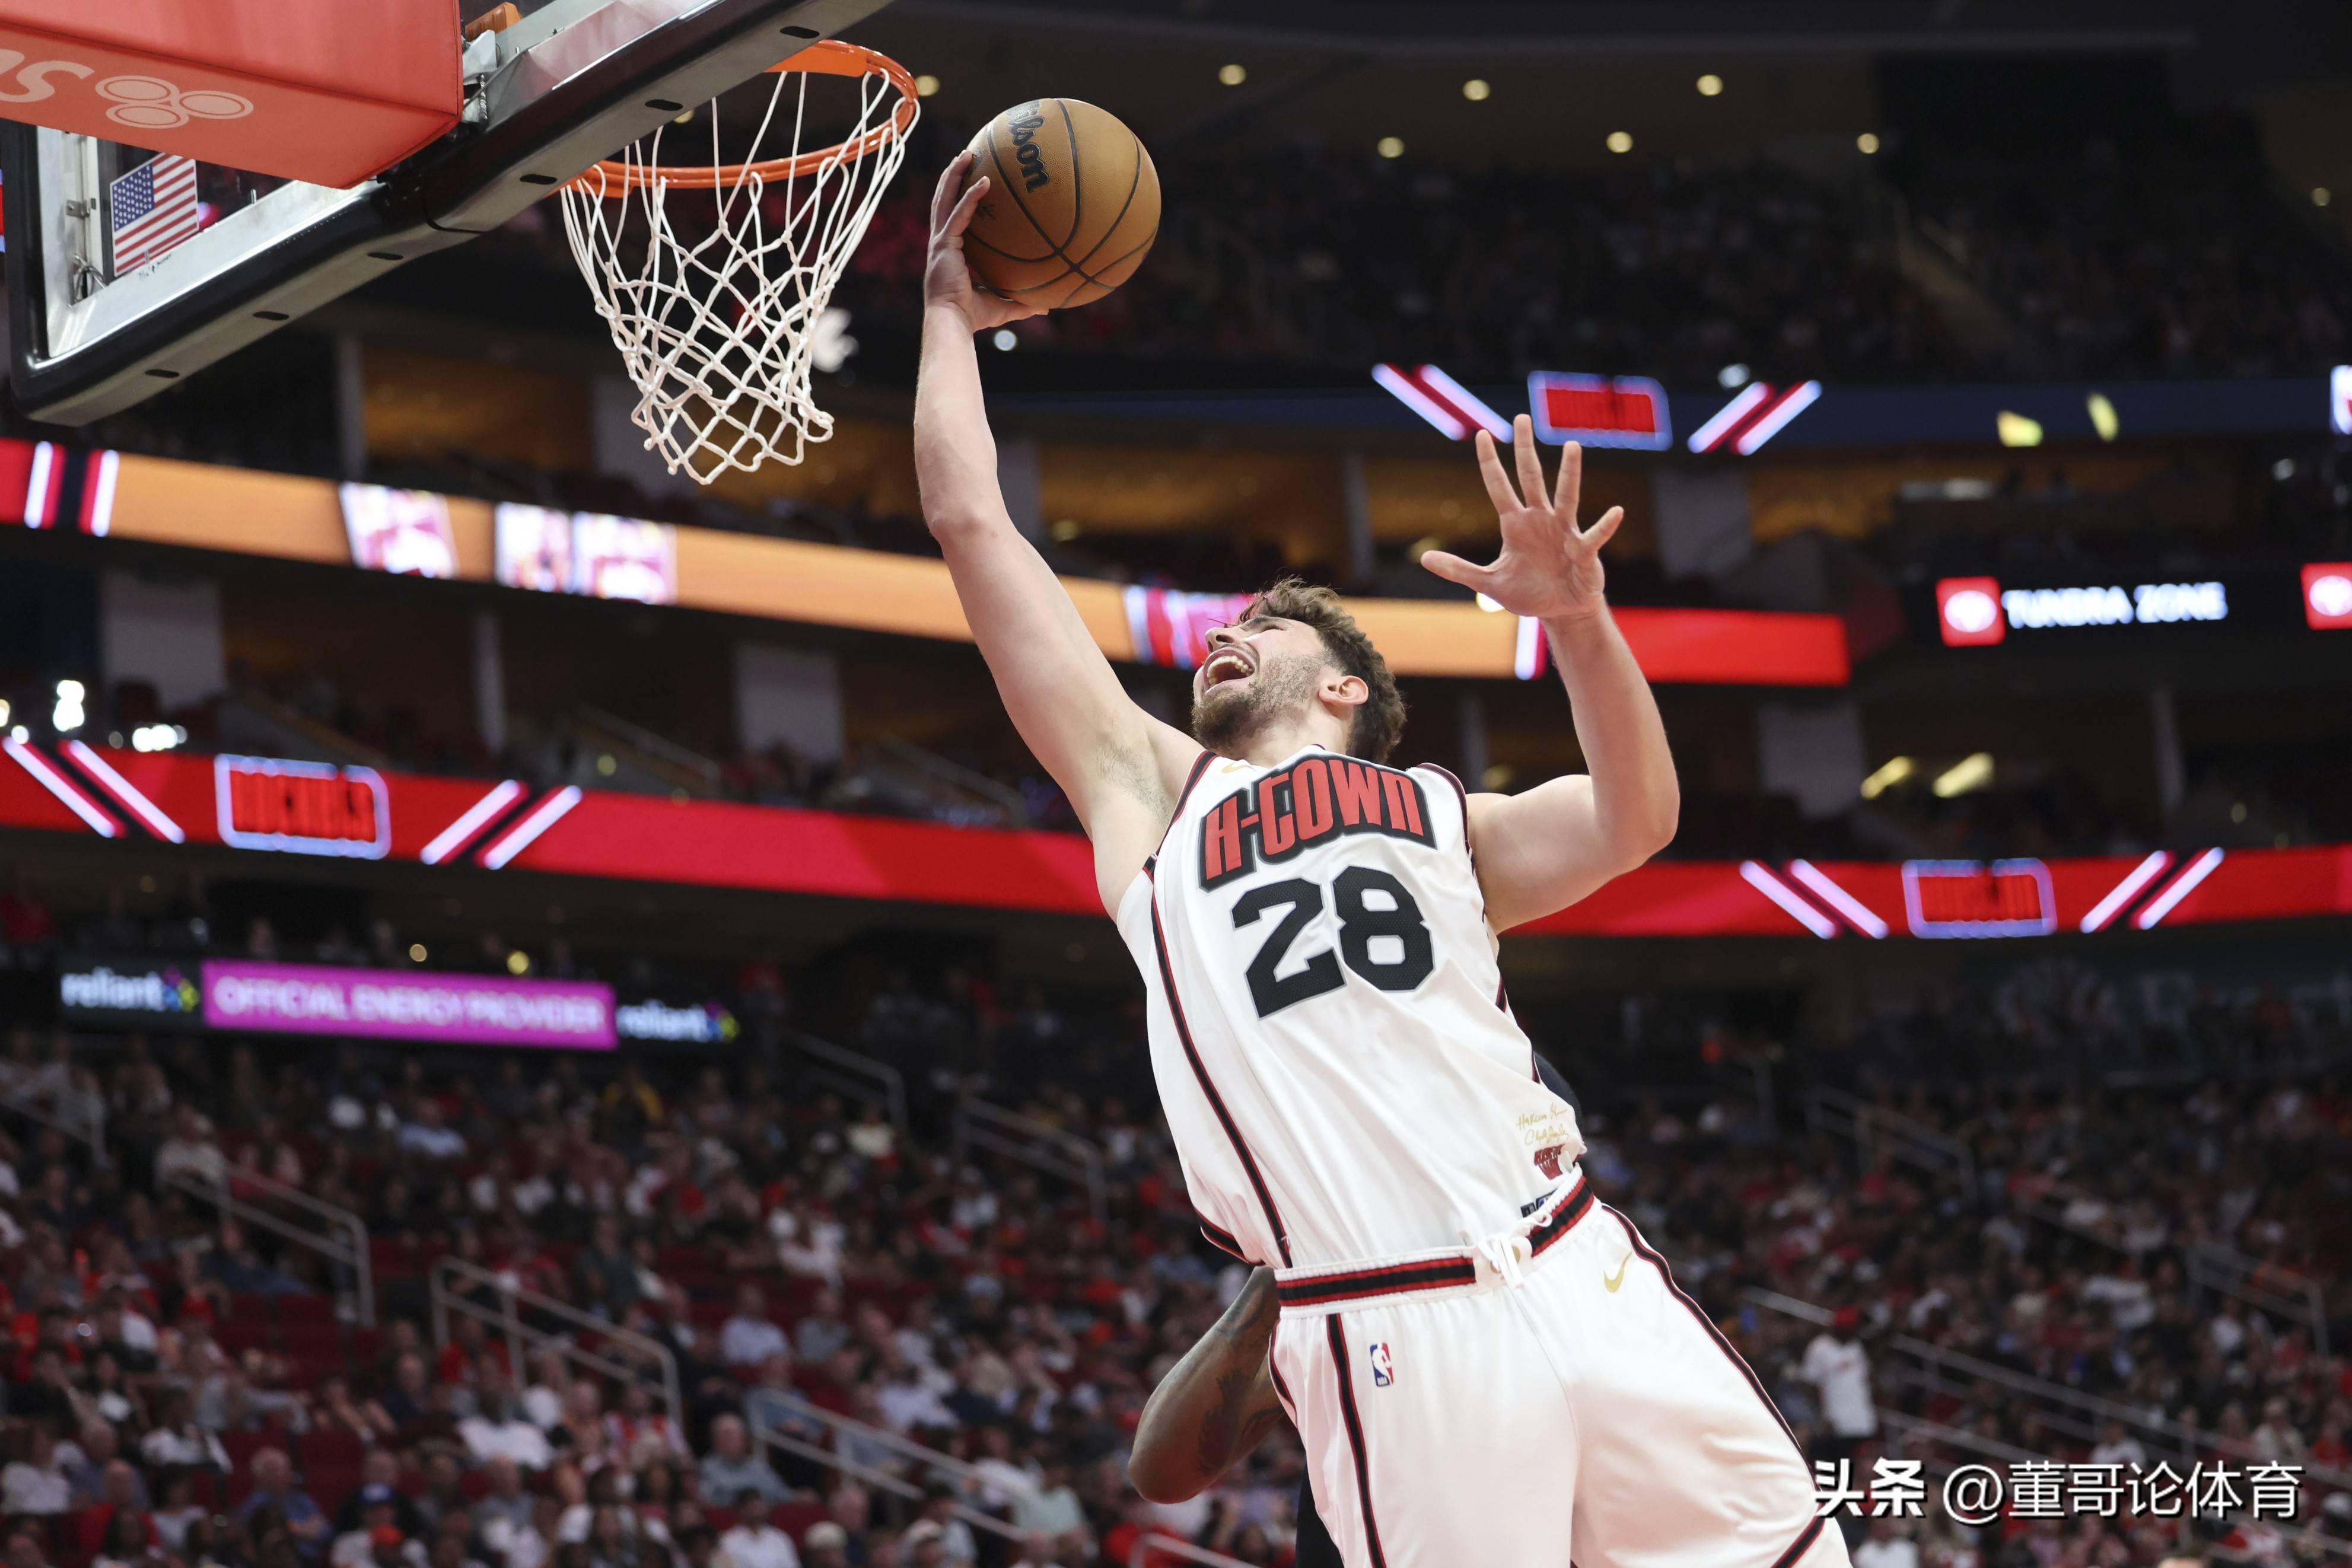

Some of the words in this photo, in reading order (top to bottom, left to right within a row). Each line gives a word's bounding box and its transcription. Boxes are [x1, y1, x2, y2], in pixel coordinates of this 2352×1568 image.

[1230, 865, 1435, 1021] 28
[215, 976, 350, 1021] OFFICIAL
[351, 983, 462, 1026] ENERGY
[462, 990, 606, 1033] PROVIDER
